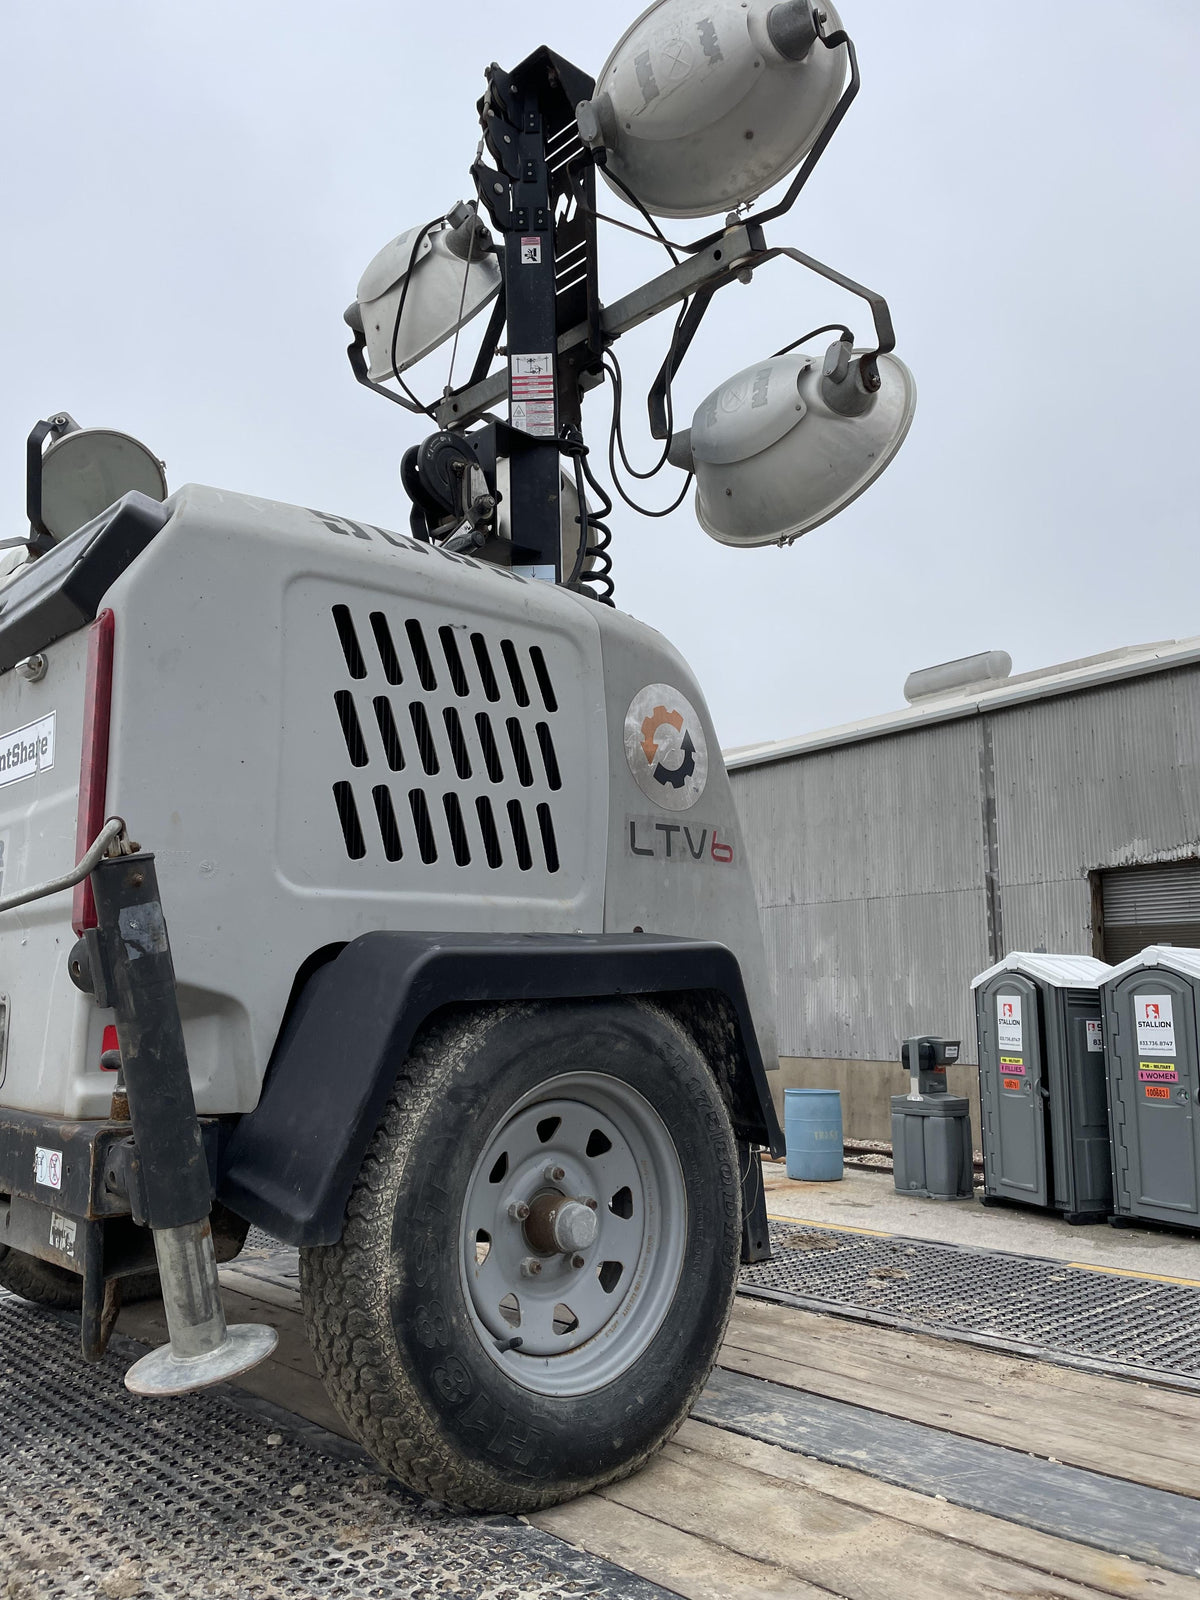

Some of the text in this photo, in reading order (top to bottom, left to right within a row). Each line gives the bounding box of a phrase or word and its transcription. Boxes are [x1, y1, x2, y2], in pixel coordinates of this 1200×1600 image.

[629, 821, 733, 863] LTV6
[998, 1018, 1020, 1026] STALLION
[1138, 1020, 1172, 1028] STALLION
[1145, 1072, 1176, 1080] WOMEN
